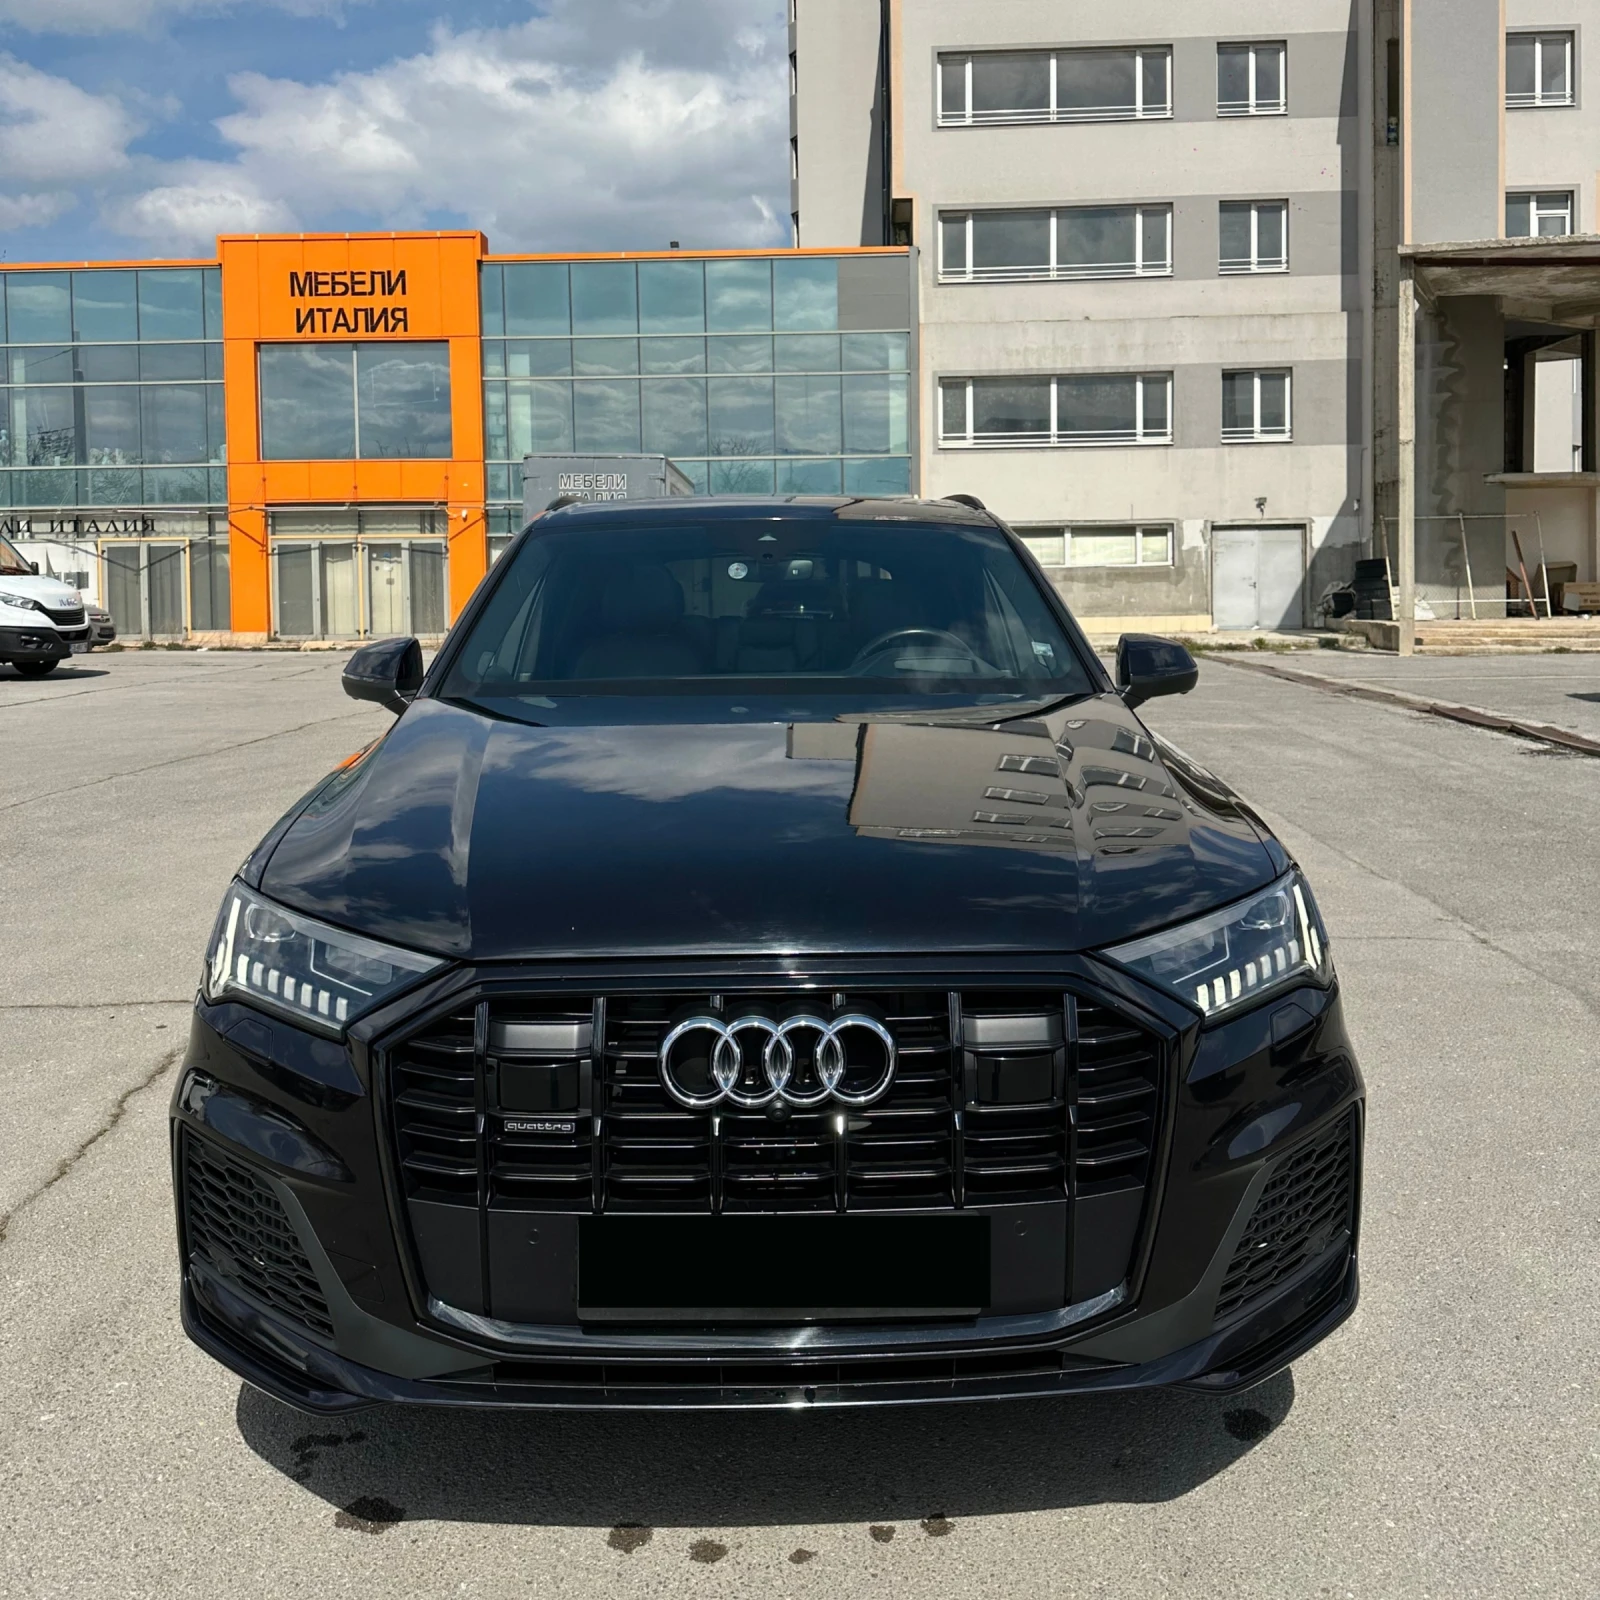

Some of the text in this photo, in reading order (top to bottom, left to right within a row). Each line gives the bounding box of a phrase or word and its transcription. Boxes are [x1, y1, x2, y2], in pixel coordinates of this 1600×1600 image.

[290, 270, 406, 297] МЕБЕЛИ
[296, 307, 408, 333] ИТАЛИЯ
[559, 473, 627, 489] МЕБЕЛИ
[49, 518, 157, 533] ИТАЛИЯ
[506, 1121, 572, 1131] quattro
